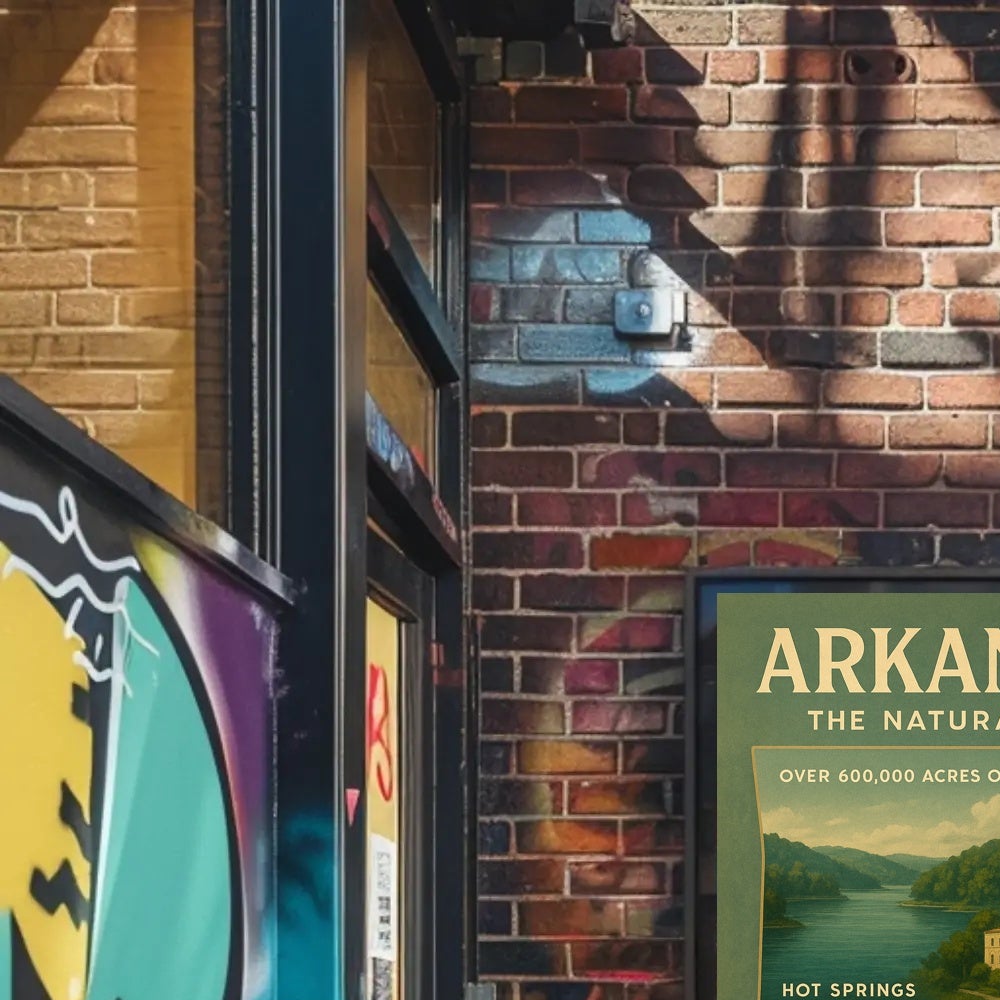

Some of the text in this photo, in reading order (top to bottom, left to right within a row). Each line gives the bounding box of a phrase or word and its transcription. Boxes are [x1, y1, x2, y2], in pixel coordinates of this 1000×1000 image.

[807, 710, 865, 731] THE
[779, 769, 830, 783] OVER
[838, 768, 915, 785] 600,000
[921, 769, 981, 783] ACRES
[782, 982, 916, 998] HOT SPRINGS
